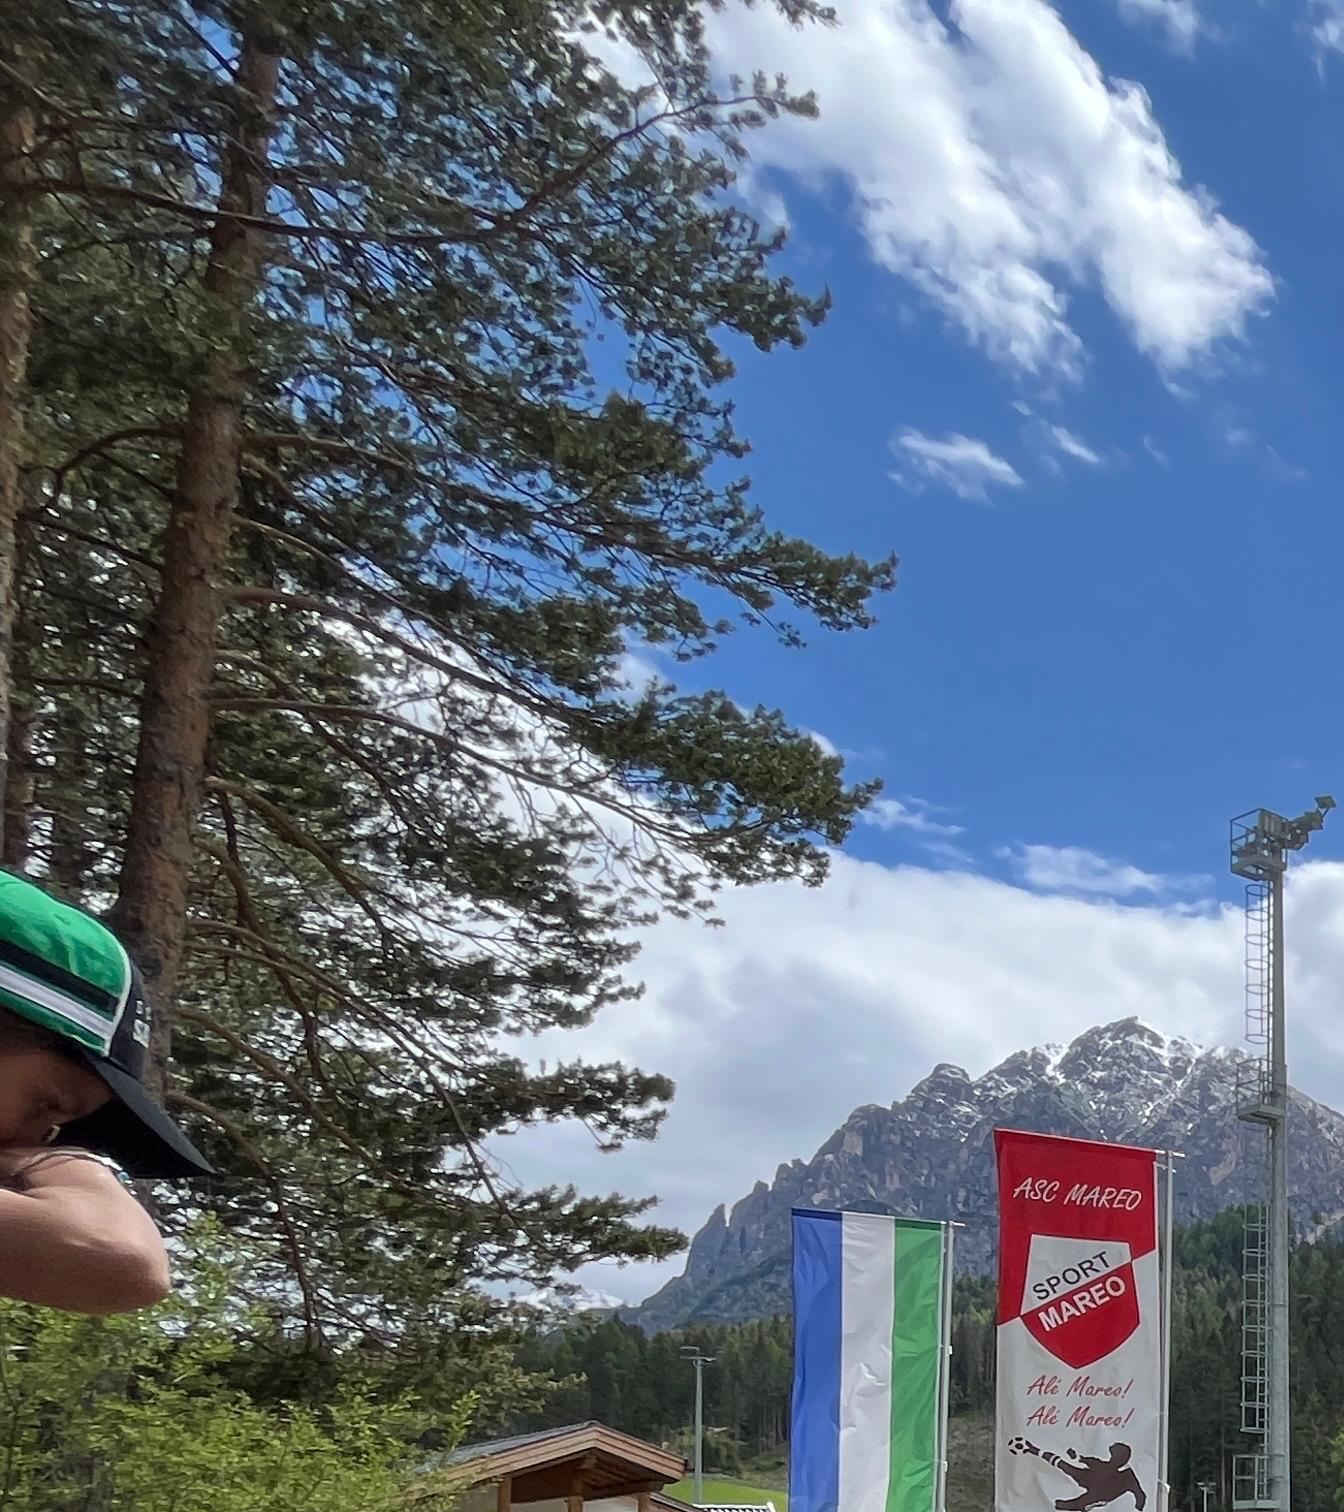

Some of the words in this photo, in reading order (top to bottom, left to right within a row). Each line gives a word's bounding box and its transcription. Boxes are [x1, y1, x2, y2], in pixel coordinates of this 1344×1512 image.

[1012, 1177, 1060, 1203] ASC
[1063, 1184, 1142, 1211] MAREO
[1032, 1251, 1110, 1300] SPORT
[1038, 1276, 1126, 1332] MAREO
[1026, 1374, 1061, 1396] Alé
[1065, 1375, 1134, 1399] Mareo!
[1025, 1405, 1061, 1427] Alé
[1065, 1405, 1136, 1429] Mareo!
